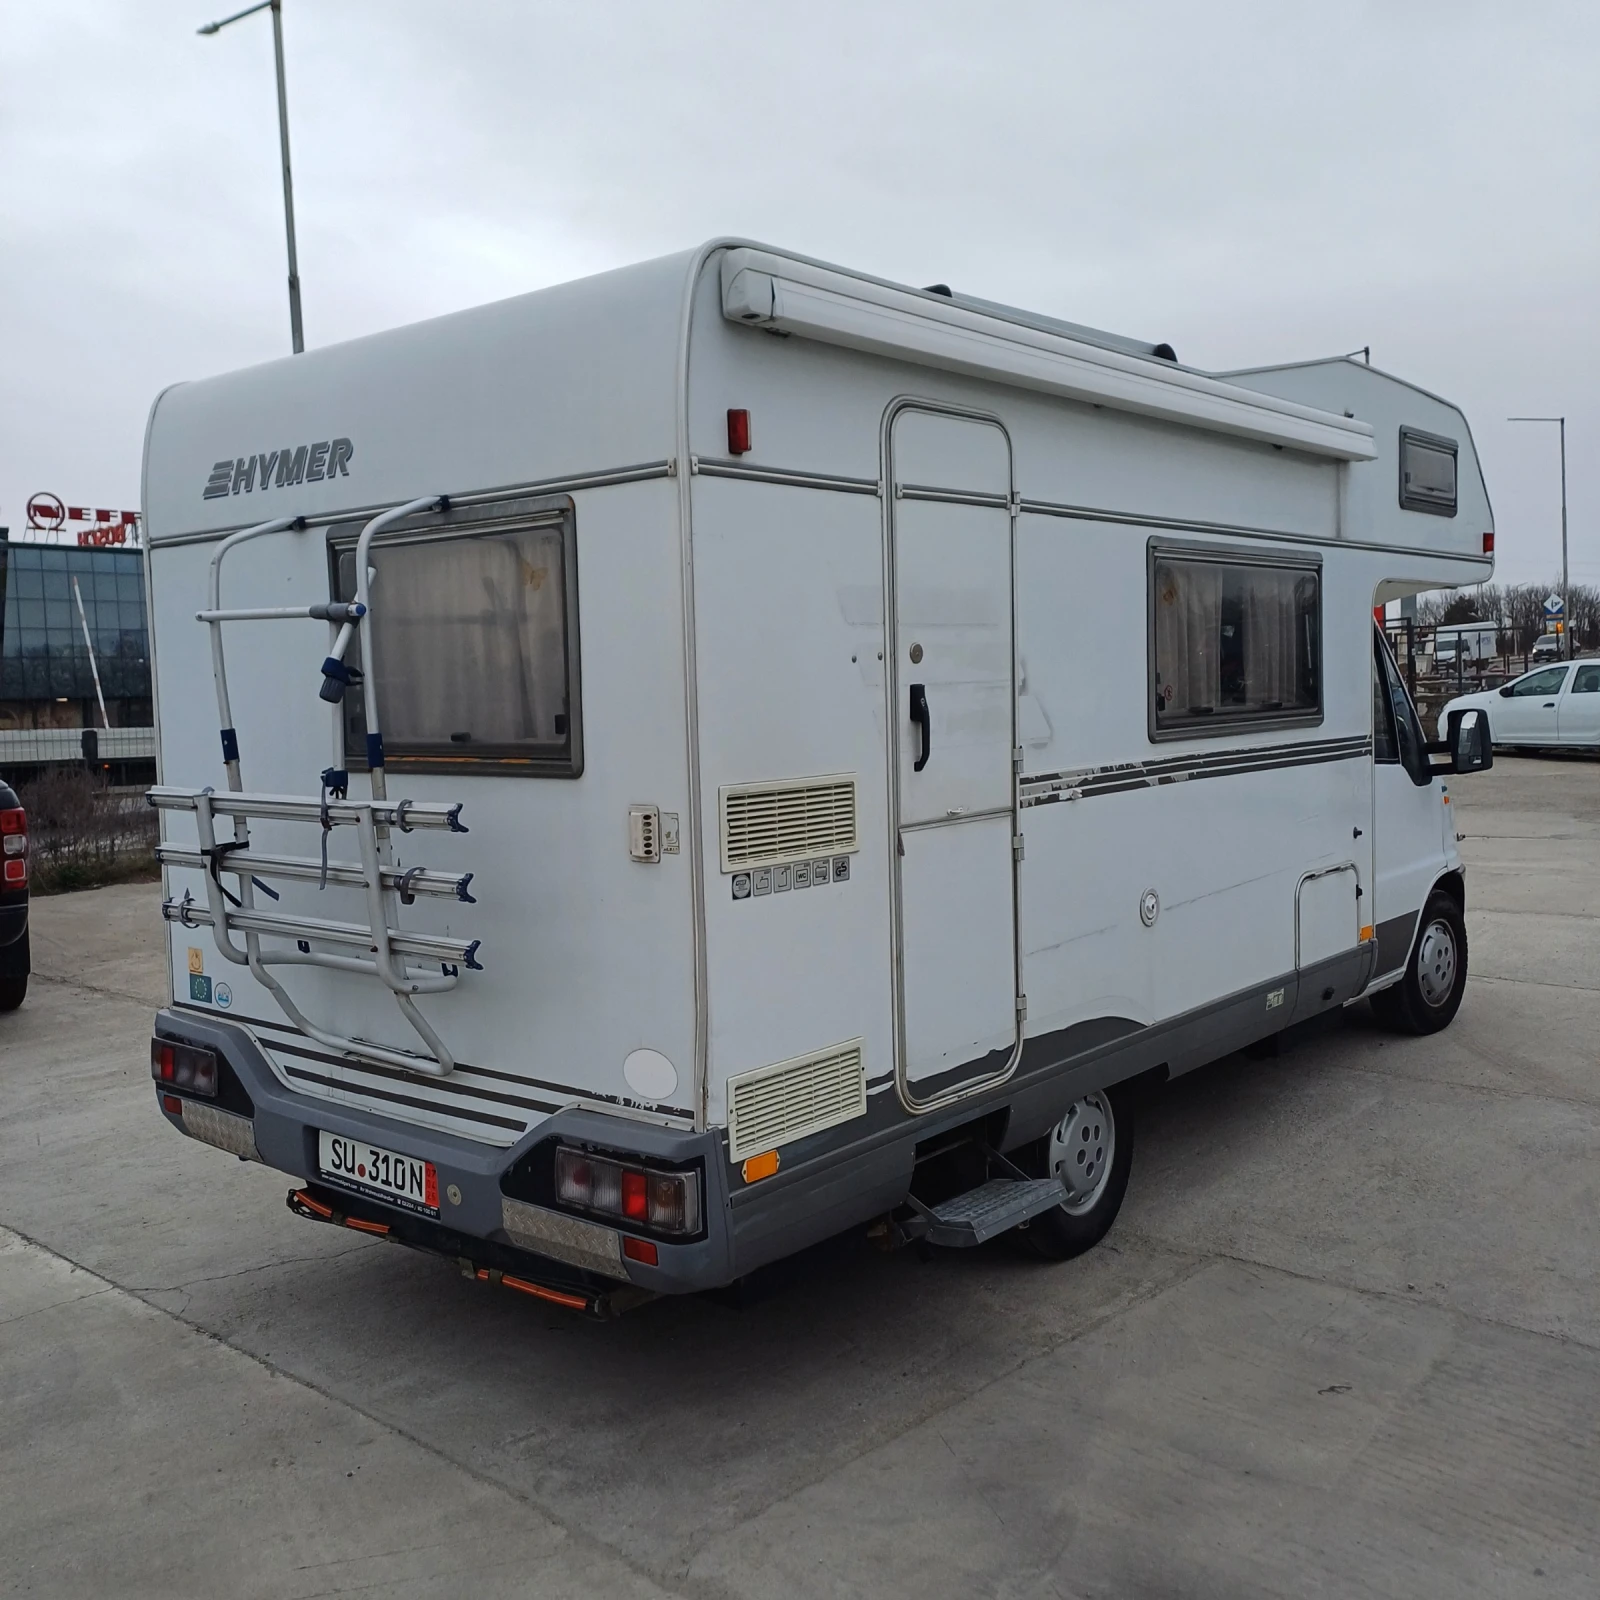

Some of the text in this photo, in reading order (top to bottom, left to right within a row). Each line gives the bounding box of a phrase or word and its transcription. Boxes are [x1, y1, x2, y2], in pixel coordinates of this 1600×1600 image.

[231, 437, 354, 496] HYMER
[797, 872, 807, 880] WC
[331, 1138, 423, 1197] SU 310N
